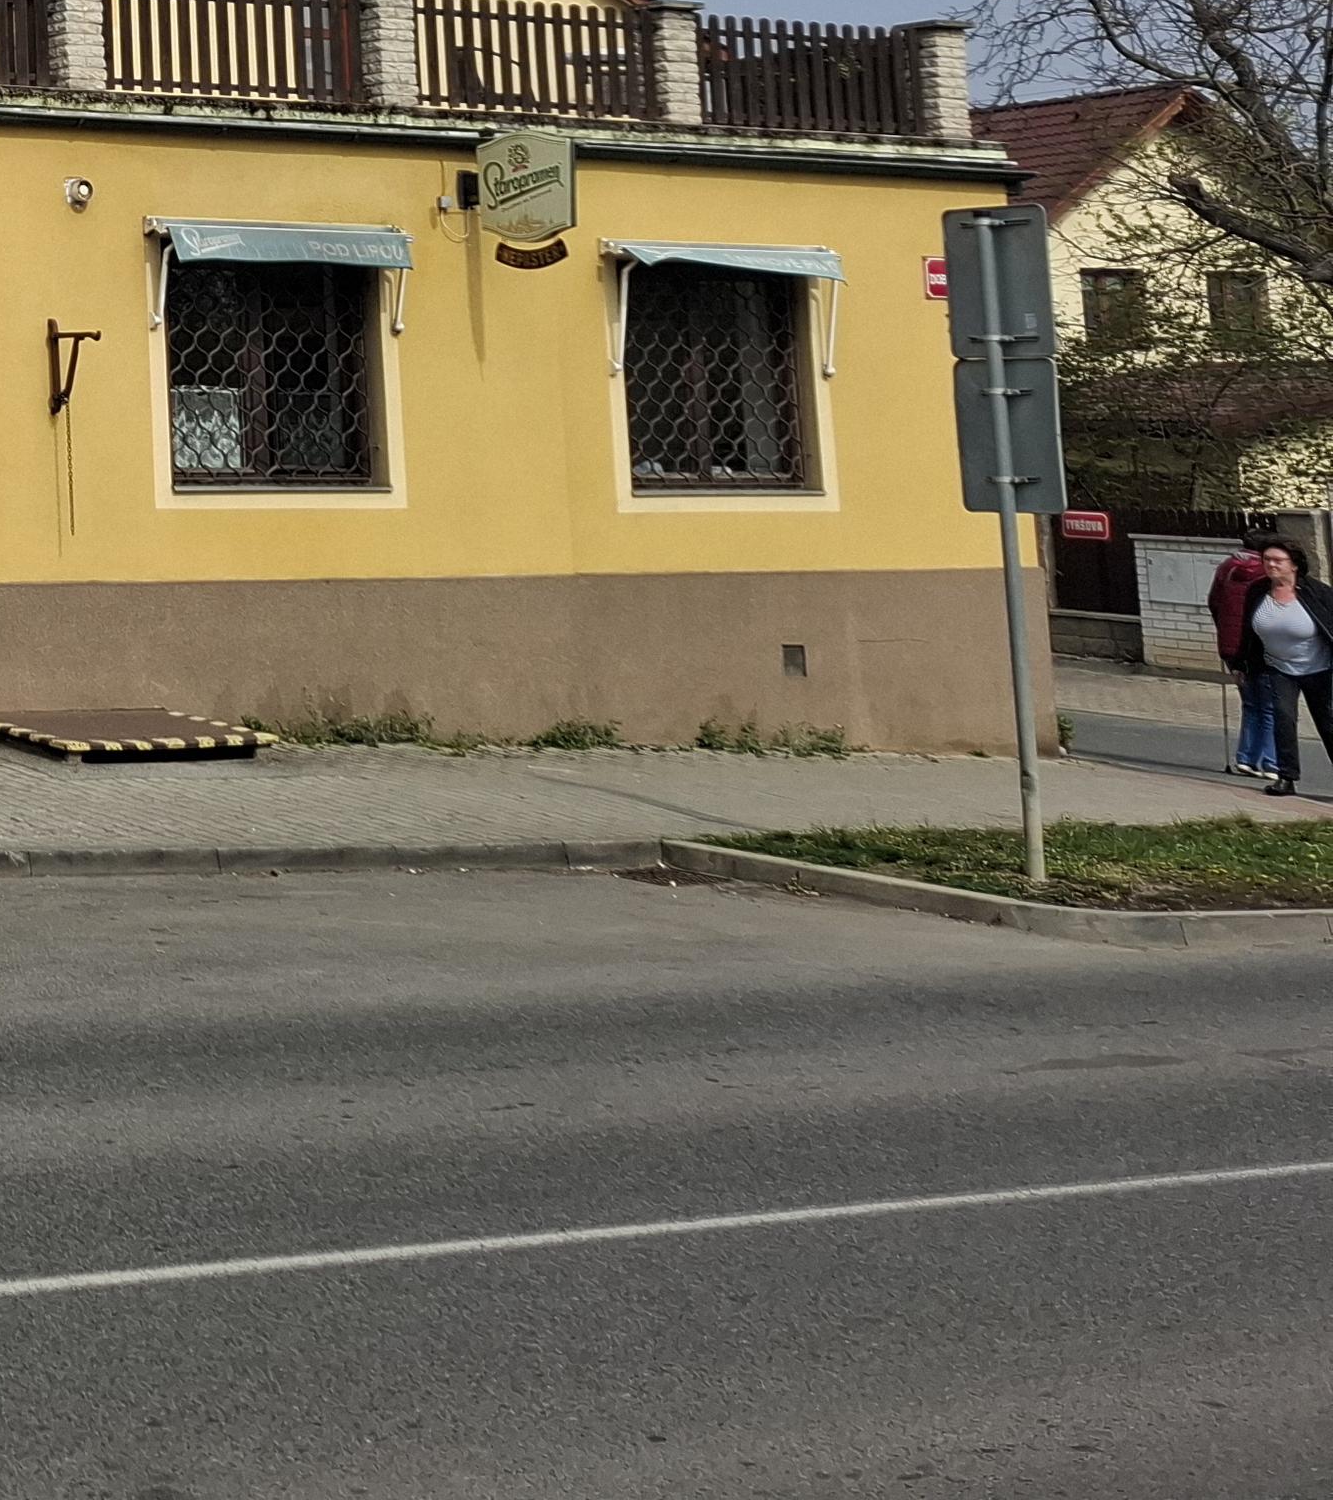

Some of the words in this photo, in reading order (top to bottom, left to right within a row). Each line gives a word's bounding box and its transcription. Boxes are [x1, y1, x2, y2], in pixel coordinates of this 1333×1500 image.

[483, 162, 565, 210] Staropramen
[308, 240, 350, 257] POD
[1065, 519, 1103, 532] TYRŠOVA
